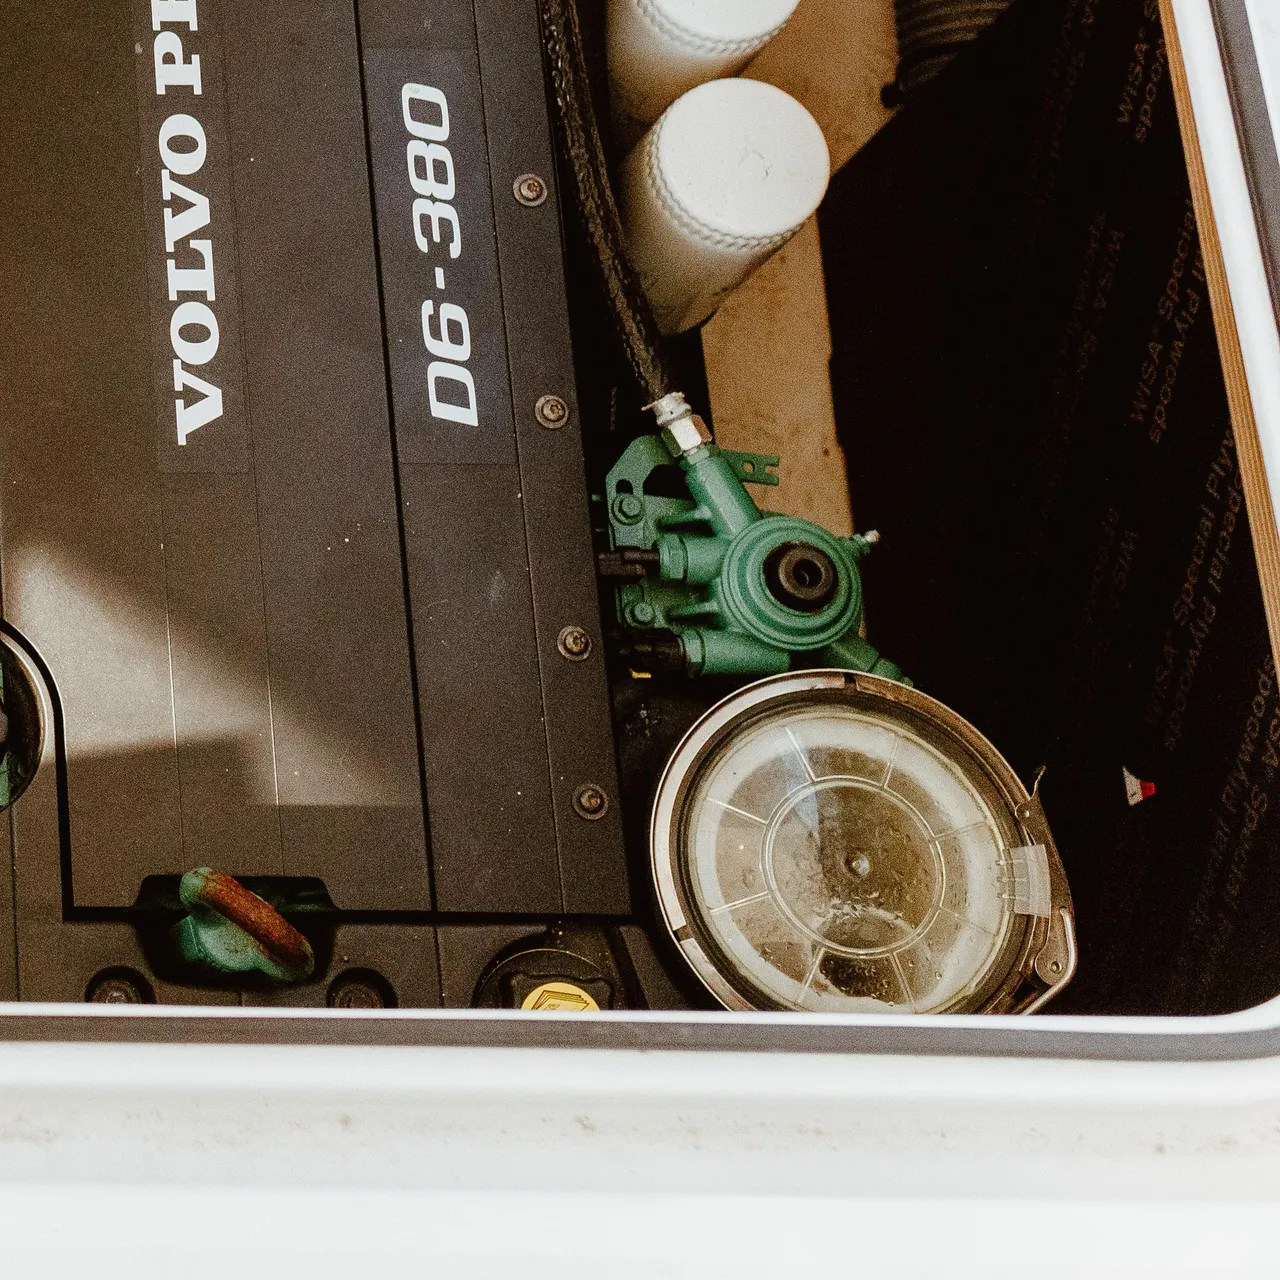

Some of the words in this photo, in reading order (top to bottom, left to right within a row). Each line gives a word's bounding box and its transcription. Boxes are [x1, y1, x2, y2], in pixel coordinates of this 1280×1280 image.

[158, 113, 224, 446] VOLVO
[401, 82, 479, 427] D6-380
[1148, 287, 1202, 442] Plywoods
[1169, 505, 1217, 627] Special
[1161, 596, 1216, 748] Plywoods
[1220, 652, 1275, 814] Plywoods
